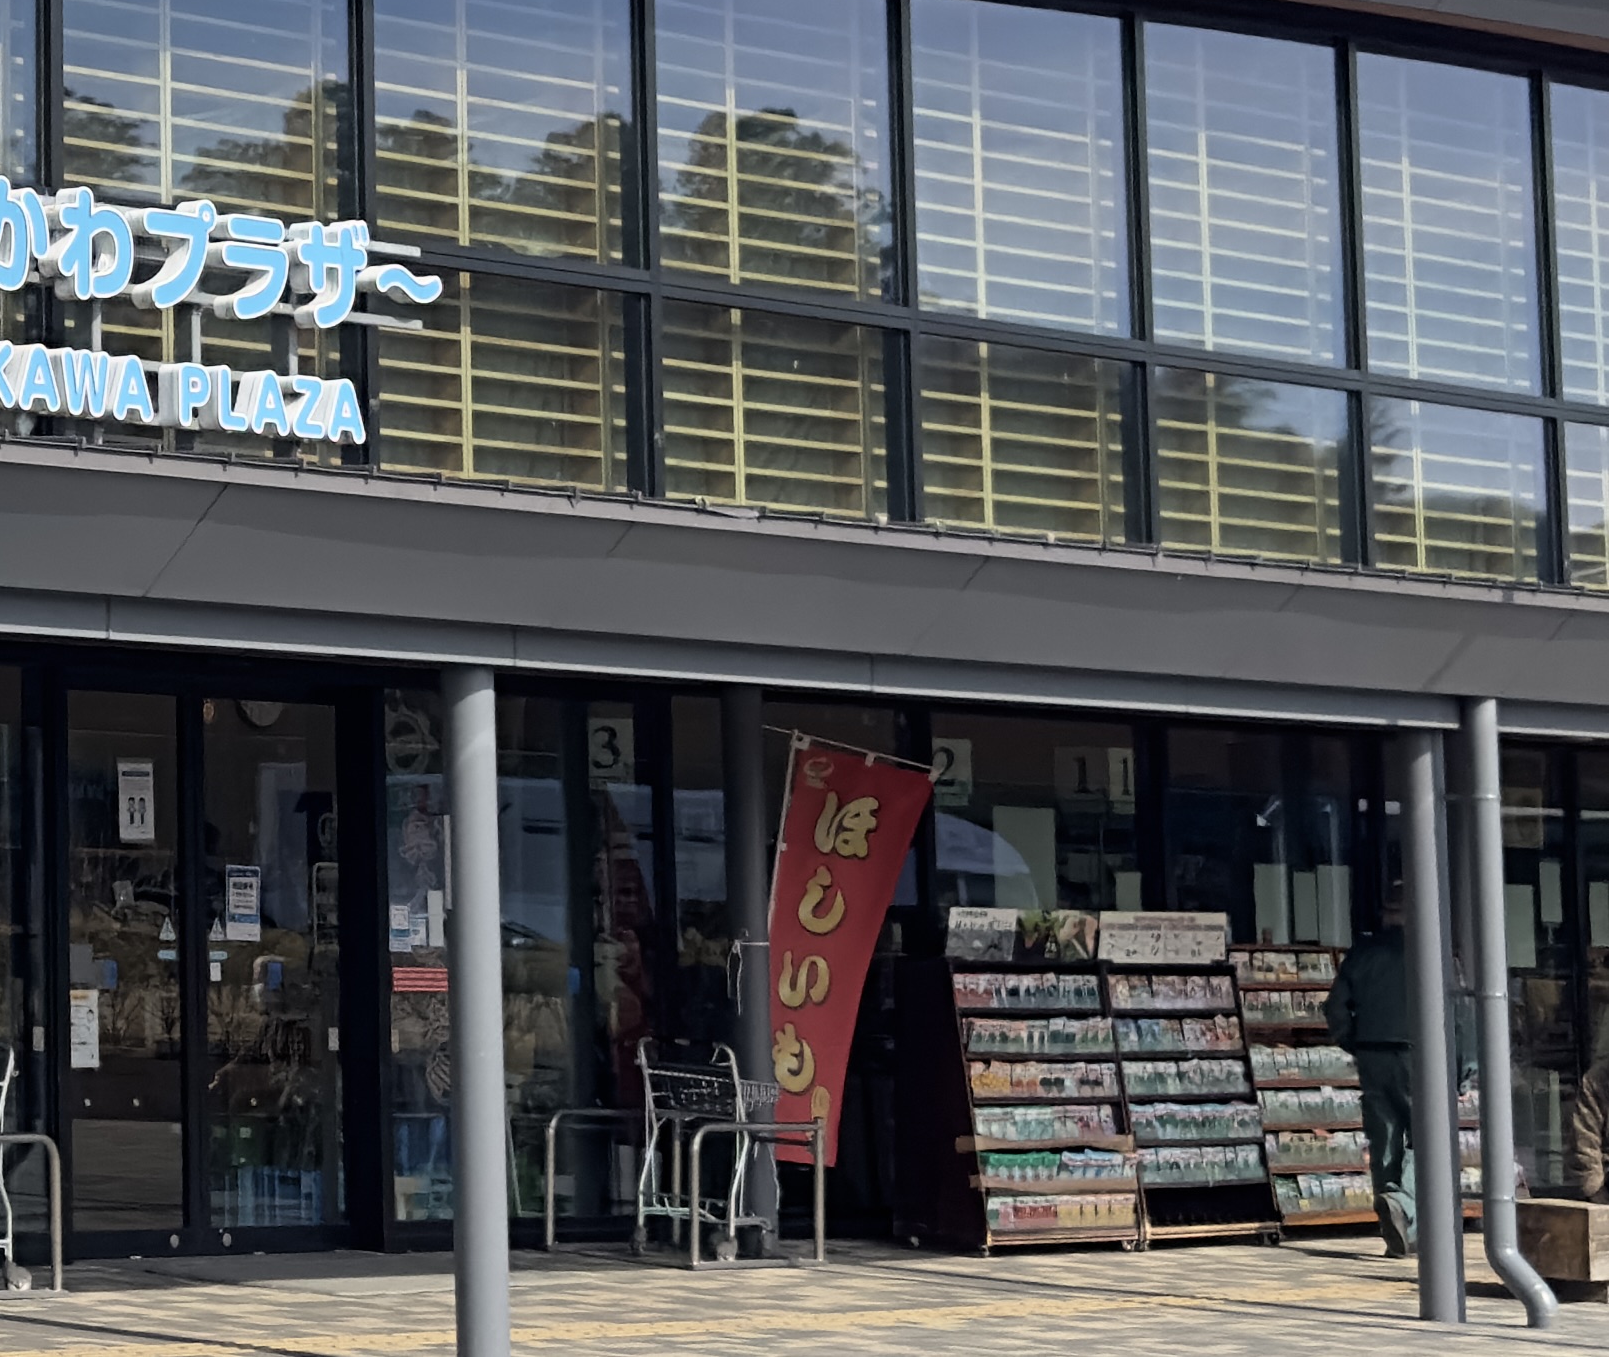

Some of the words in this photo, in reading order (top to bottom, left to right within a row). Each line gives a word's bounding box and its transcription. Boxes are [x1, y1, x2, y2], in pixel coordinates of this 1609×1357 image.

[174, 363, 366, 445] PLAZA
[592, 726, 622, 769] 3
[932, 746, 955, 787] 2
[772, 790, 879, 1093] ほしいも
